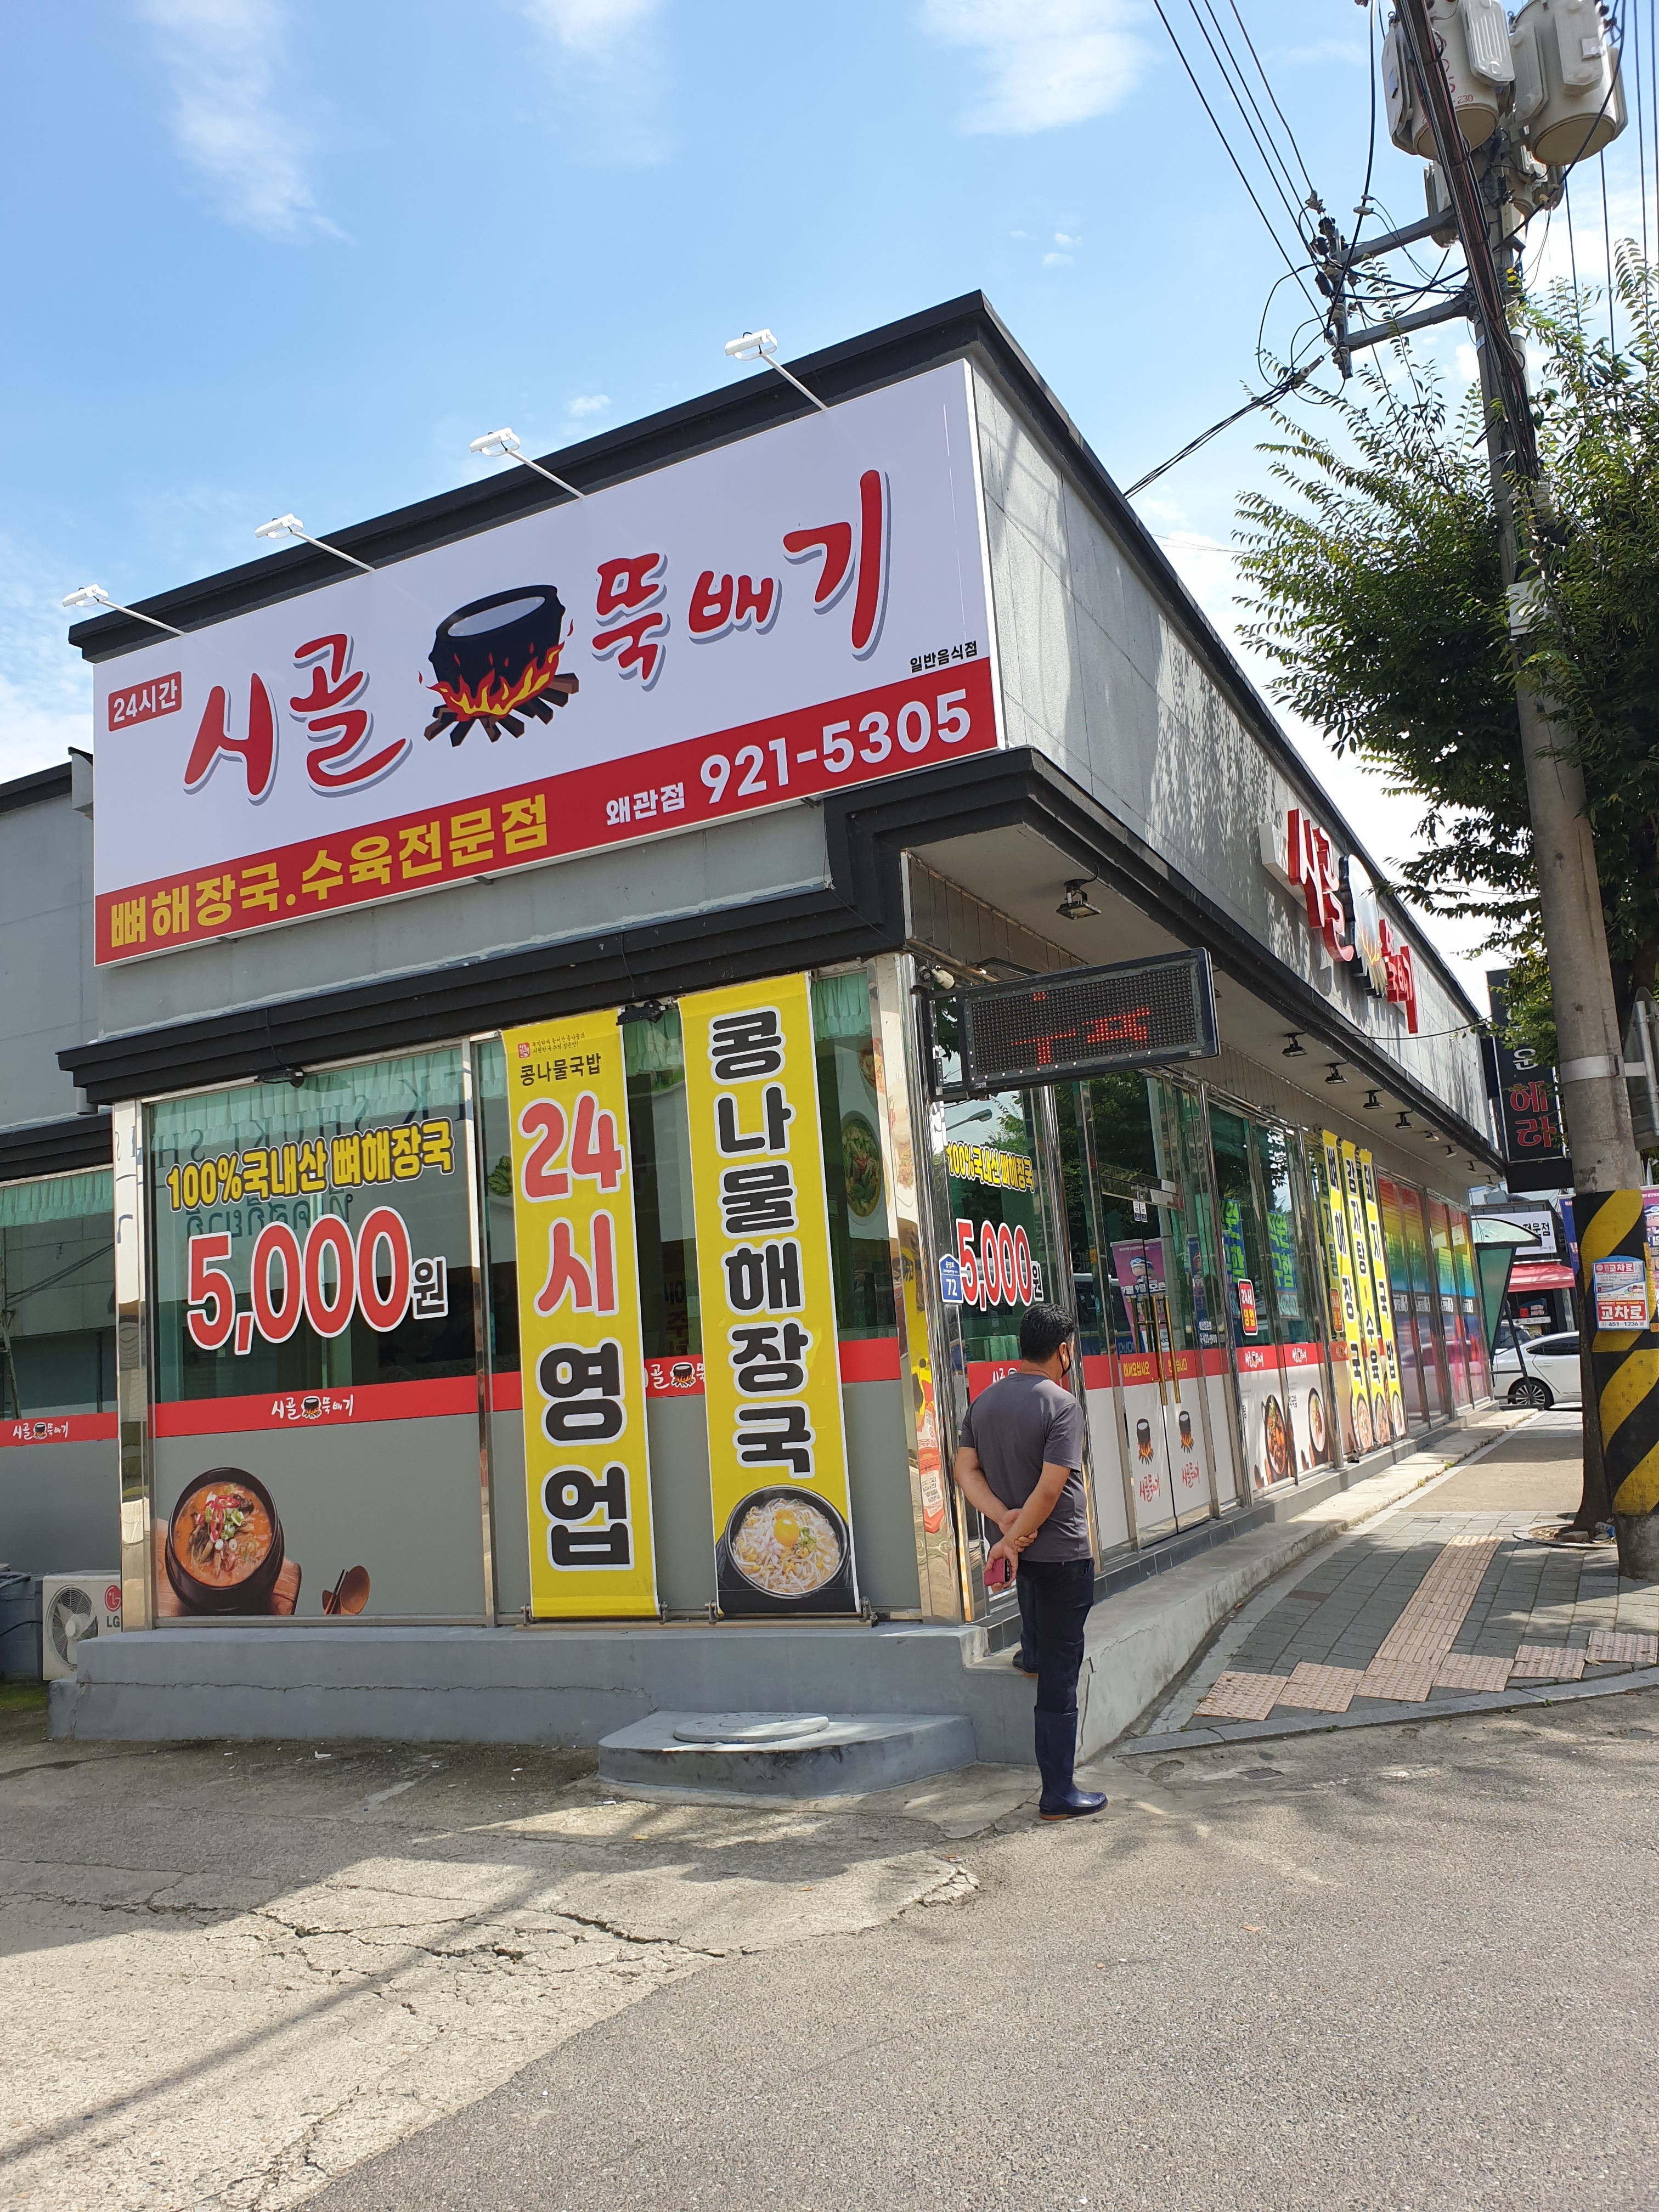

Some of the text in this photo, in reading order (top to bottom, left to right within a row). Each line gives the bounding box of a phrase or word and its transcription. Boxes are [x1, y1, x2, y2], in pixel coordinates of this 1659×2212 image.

[183, 469, 888, 803] 시골 뚝배기
[910, 641, 978, 674] 일반음식점
[112, 679, 178, 723] 24시간
[606, 689, 972, 827] 왜관점 921-5305
[520, 1052, 601, 1087] 콩나물국밥
[166, 1138, 328, 1212] 100%국내산
[330, 1117, 455, 1189] 뼈해장국
[947, 1139, 1035, 1193] 100%국내산 뼈해장국
[708, 1006, 816, 1479] 콩나물해장국
[187, 1206, 449, 1356] 5,000원
[956, 1218, 1044, 1312] 5,000원
[1326, 1146, 1364, 1389] 뼈해장국
[1362, 1162, 1397, 1381] 돼지국밥
[1609, 1263, 1634, 1273] 교차로
[946, 1278, 958, 1296] 72
[1240, 1288, 1253, 1306] 24시
[1243, 1307, 1256, 1327] 영업
[1601, 1305, 1644, 1320] 교차로
[1123, 1361, 1150, 1378] 어서오십시오
[271, 1394, 354, 1421] 시골 뚝배기
[13, 1423, 33, 1440] 시골
[106, 1616, 120, 1628] LG
